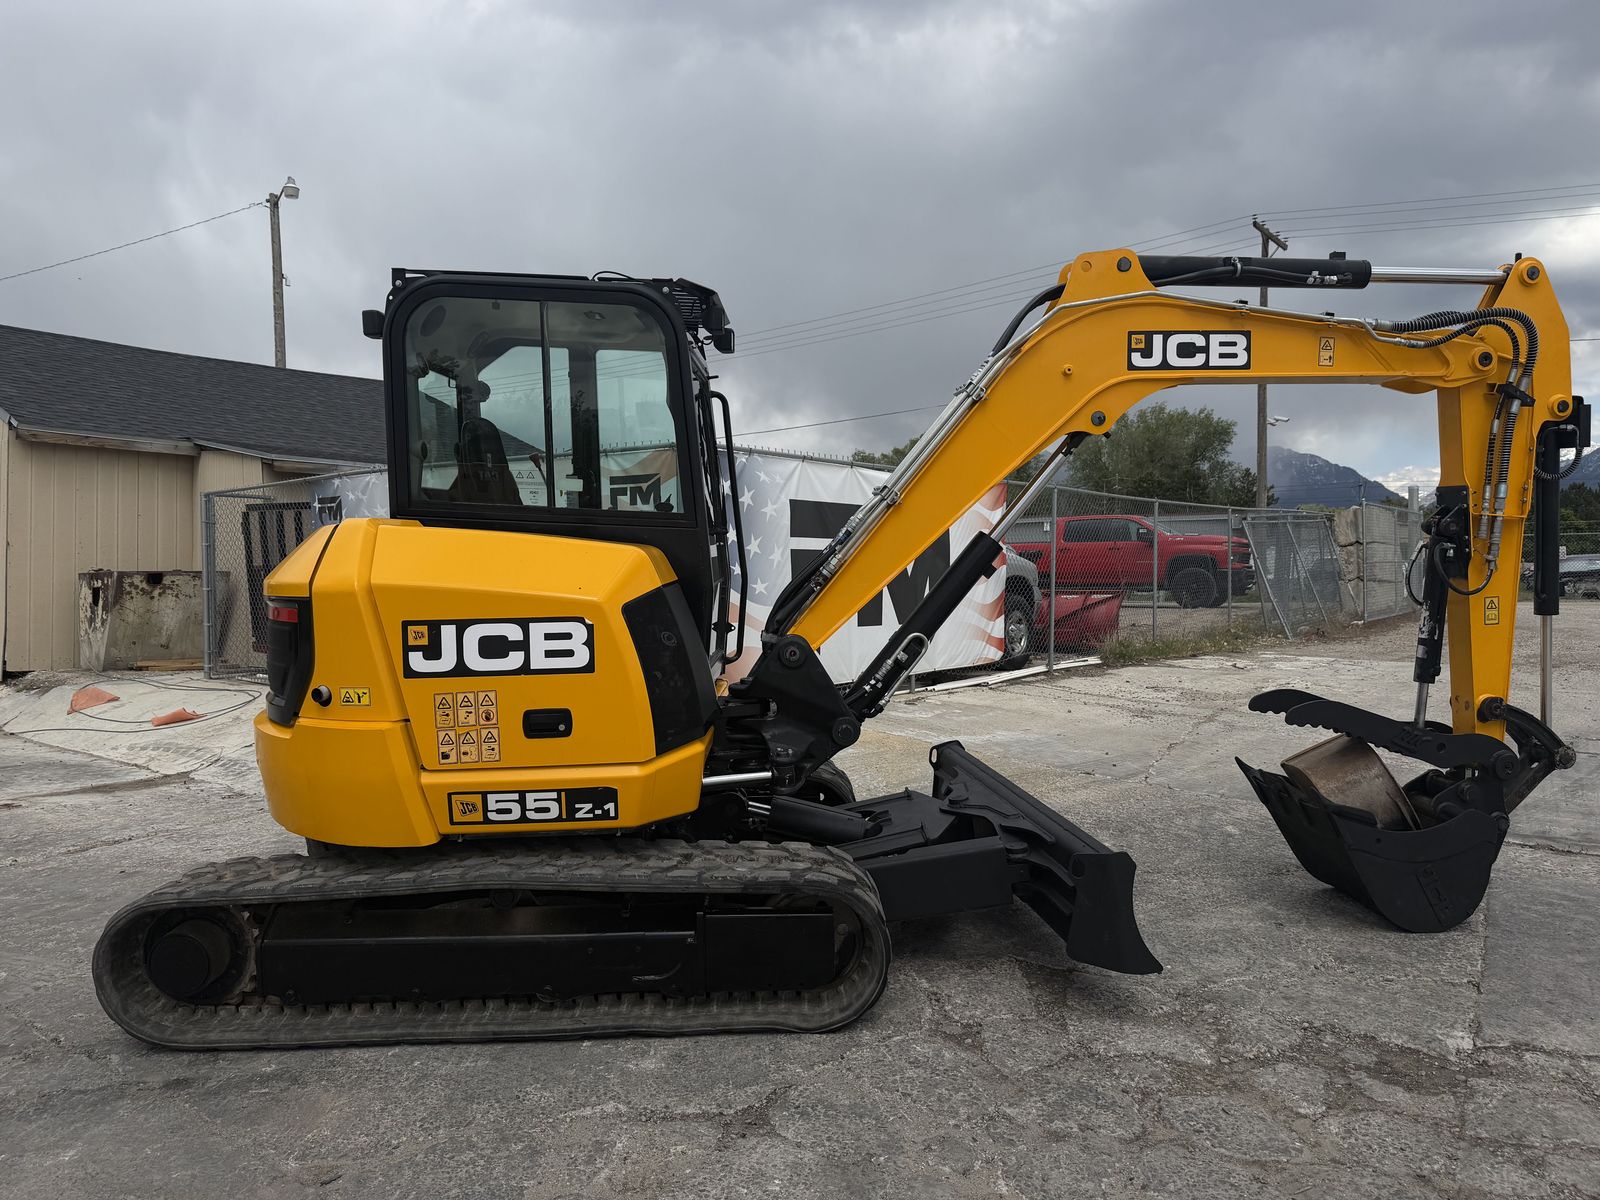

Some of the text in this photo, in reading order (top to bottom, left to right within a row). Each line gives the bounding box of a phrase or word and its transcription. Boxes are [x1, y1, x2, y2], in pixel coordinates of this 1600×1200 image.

[1131, 333, 1249, 367] JCB
[408, 621, 590, 673] JCB
[410, 629, 425, 641] JCB
[459, 800, 479, 816] JCB
[486, 792, 561, 821] 55
